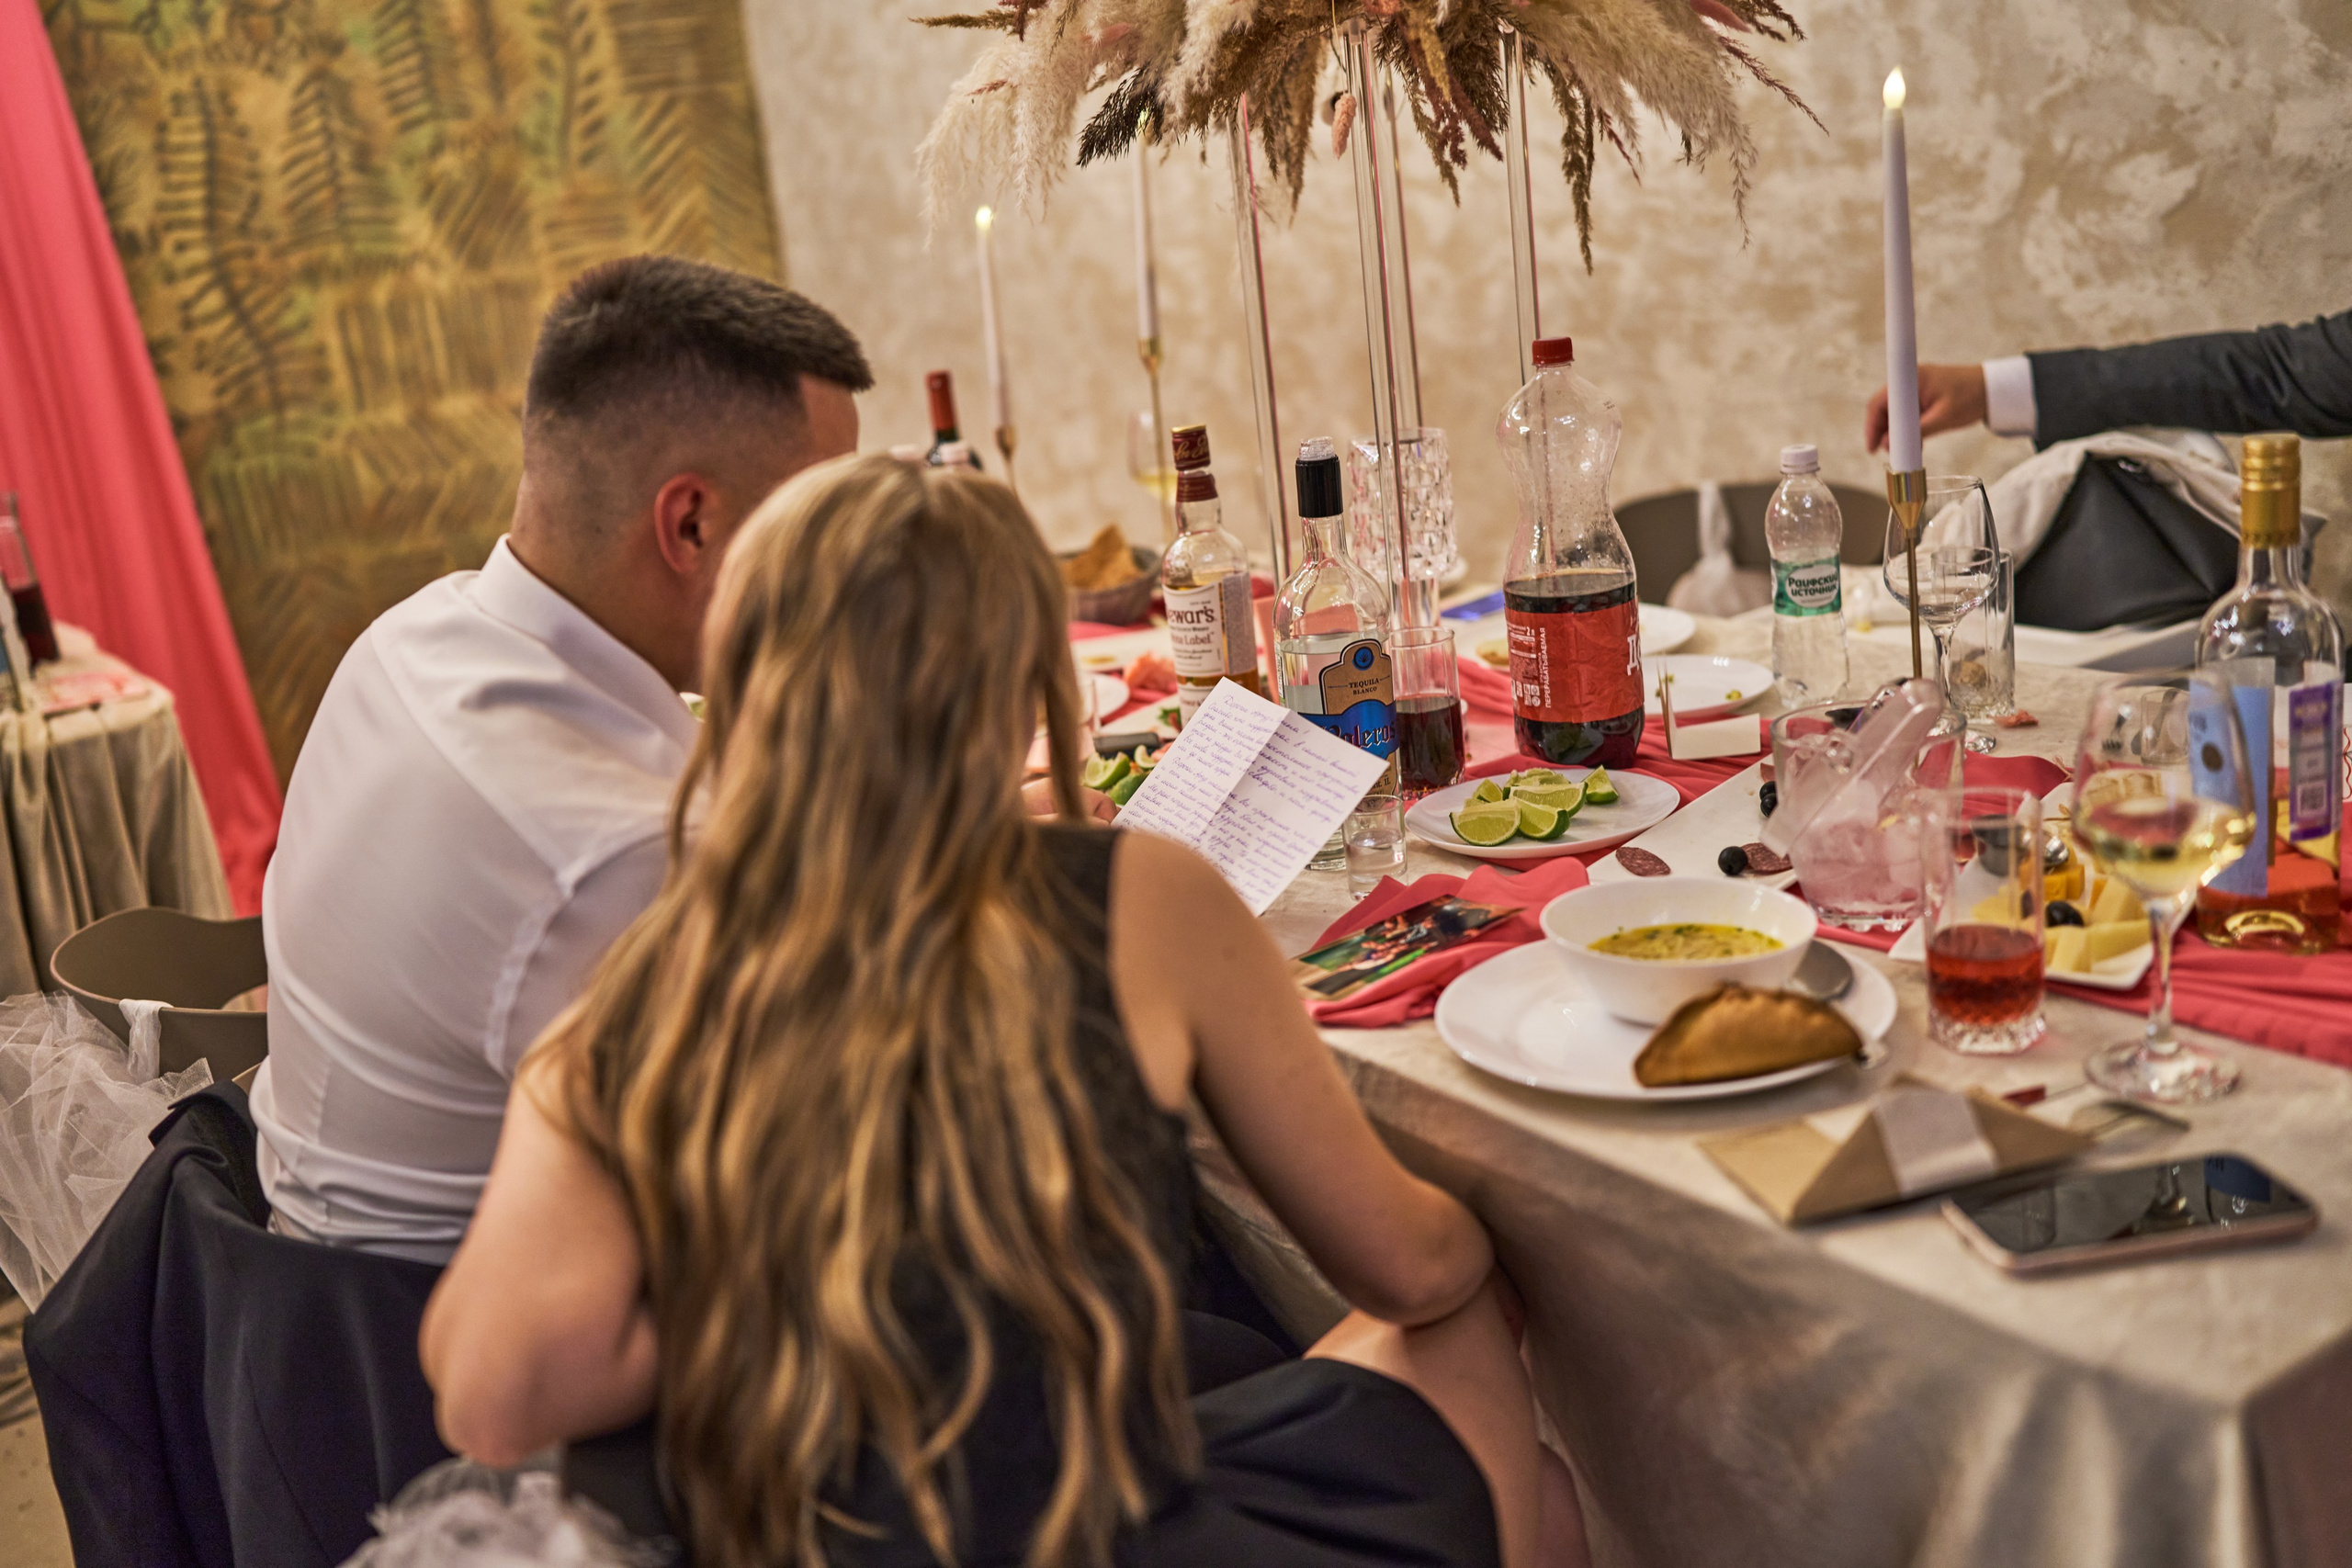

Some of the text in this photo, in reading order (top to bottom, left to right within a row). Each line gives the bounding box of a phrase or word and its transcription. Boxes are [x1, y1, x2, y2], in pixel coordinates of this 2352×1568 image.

[1792, 584, 1837, 597] источник
[1169, 605, 1216, 626] ewar's
[1539, 627, 1551, 708] ПЕРЕРАБАТЫВАЕМАЯ
[1348, 678, 1380, 689] TEQUILA
[1352, 687, 1377, 695] BLANCO
